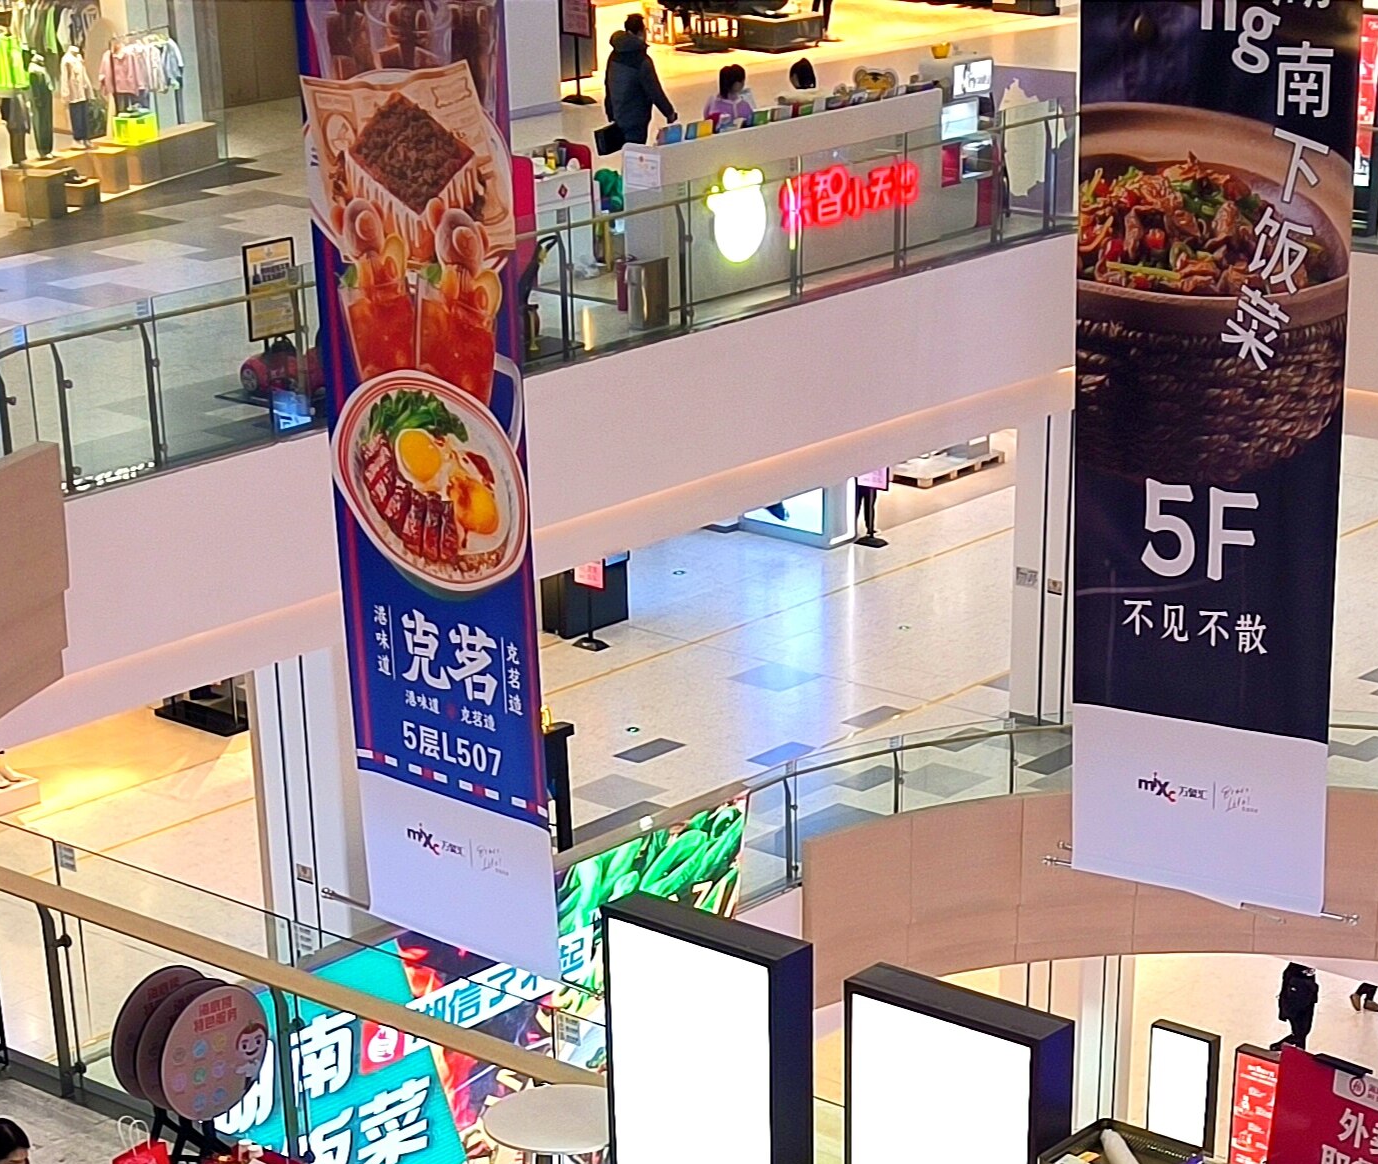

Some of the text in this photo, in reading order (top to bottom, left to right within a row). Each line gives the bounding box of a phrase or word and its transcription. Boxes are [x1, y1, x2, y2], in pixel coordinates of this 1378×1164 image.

[1221, 0, 1334, 372] 南下饭菜
[1140, 477, 1259, 581] 5F
[1122, 600, 1268, 655] 不见不散
[402, 720, 502, 777] 5层L507
